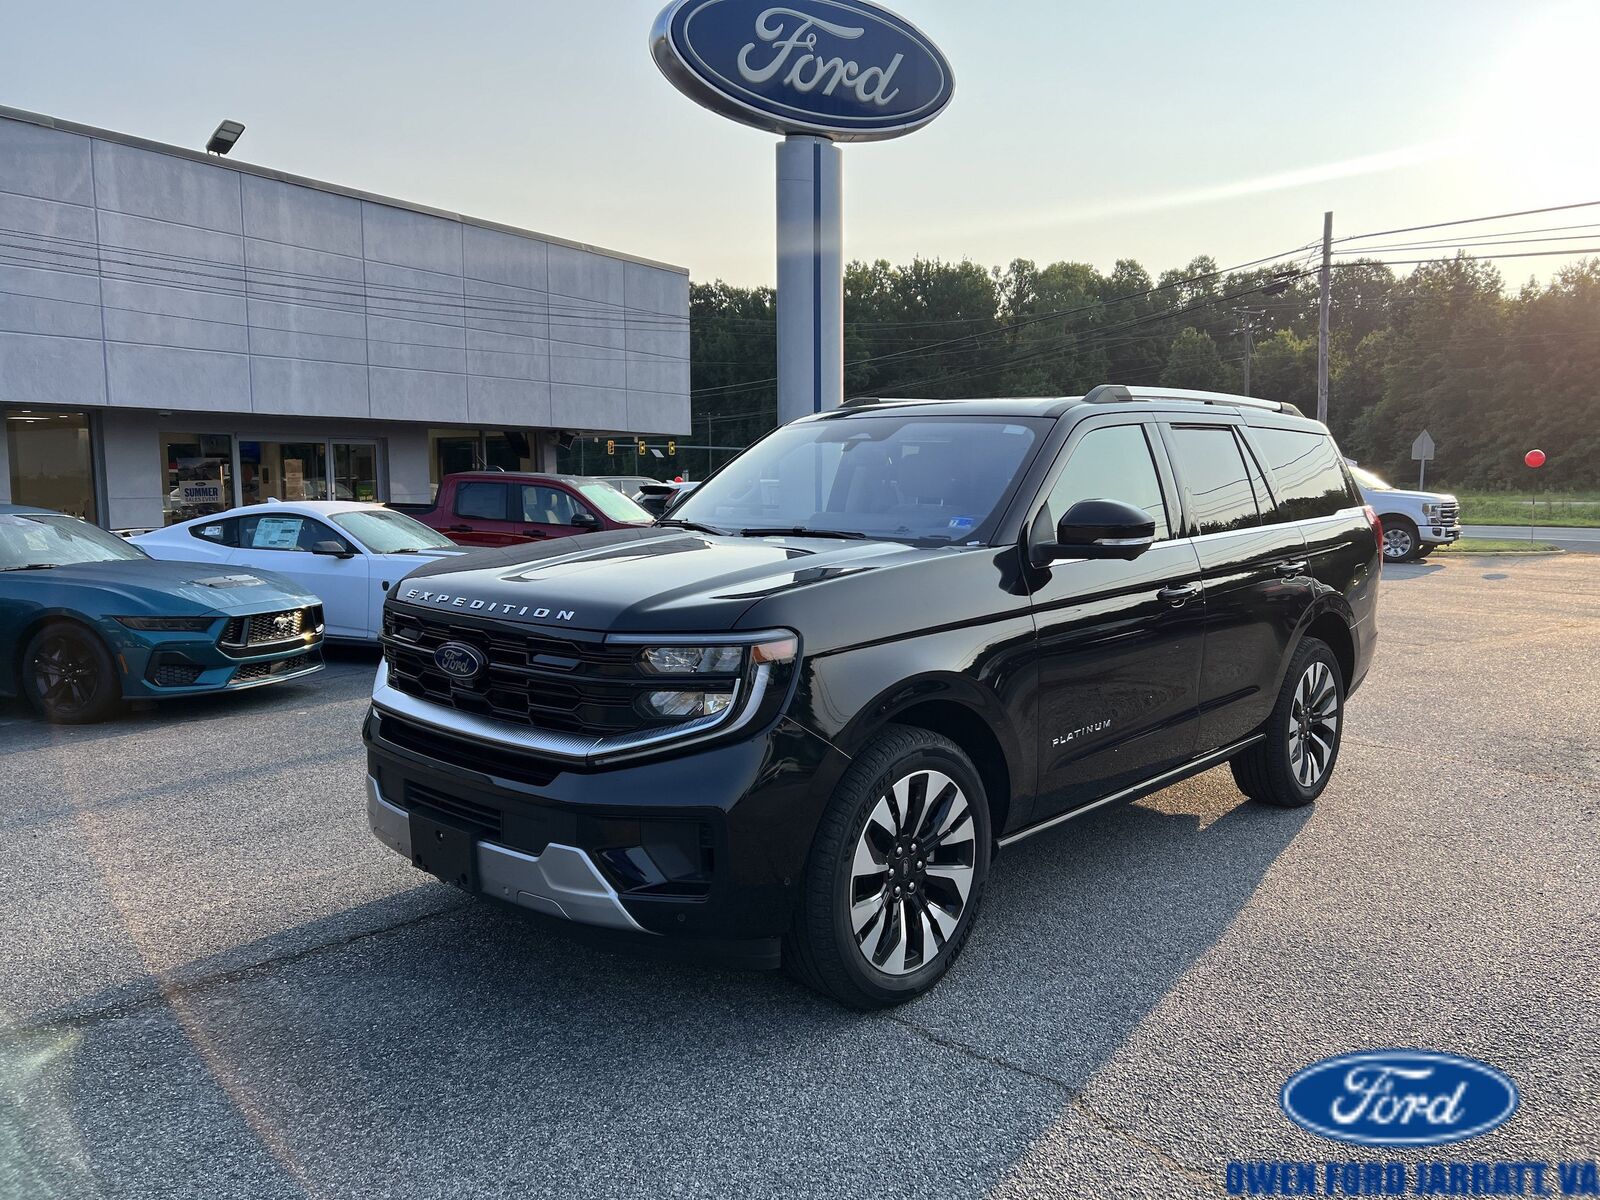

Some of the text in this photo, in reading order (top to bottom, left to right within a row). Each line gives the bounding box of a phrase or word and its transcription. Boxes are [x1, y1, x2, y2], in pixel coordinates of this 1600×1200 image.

[737, 7, 904, 106] Ford
[184, 487, 218, 497] SUMMER
[406, 588, 575, 621] EXPEDITION
[442, 649, 469, 672] Ford
[1052, 719, 1111, 748] PLATINUM
